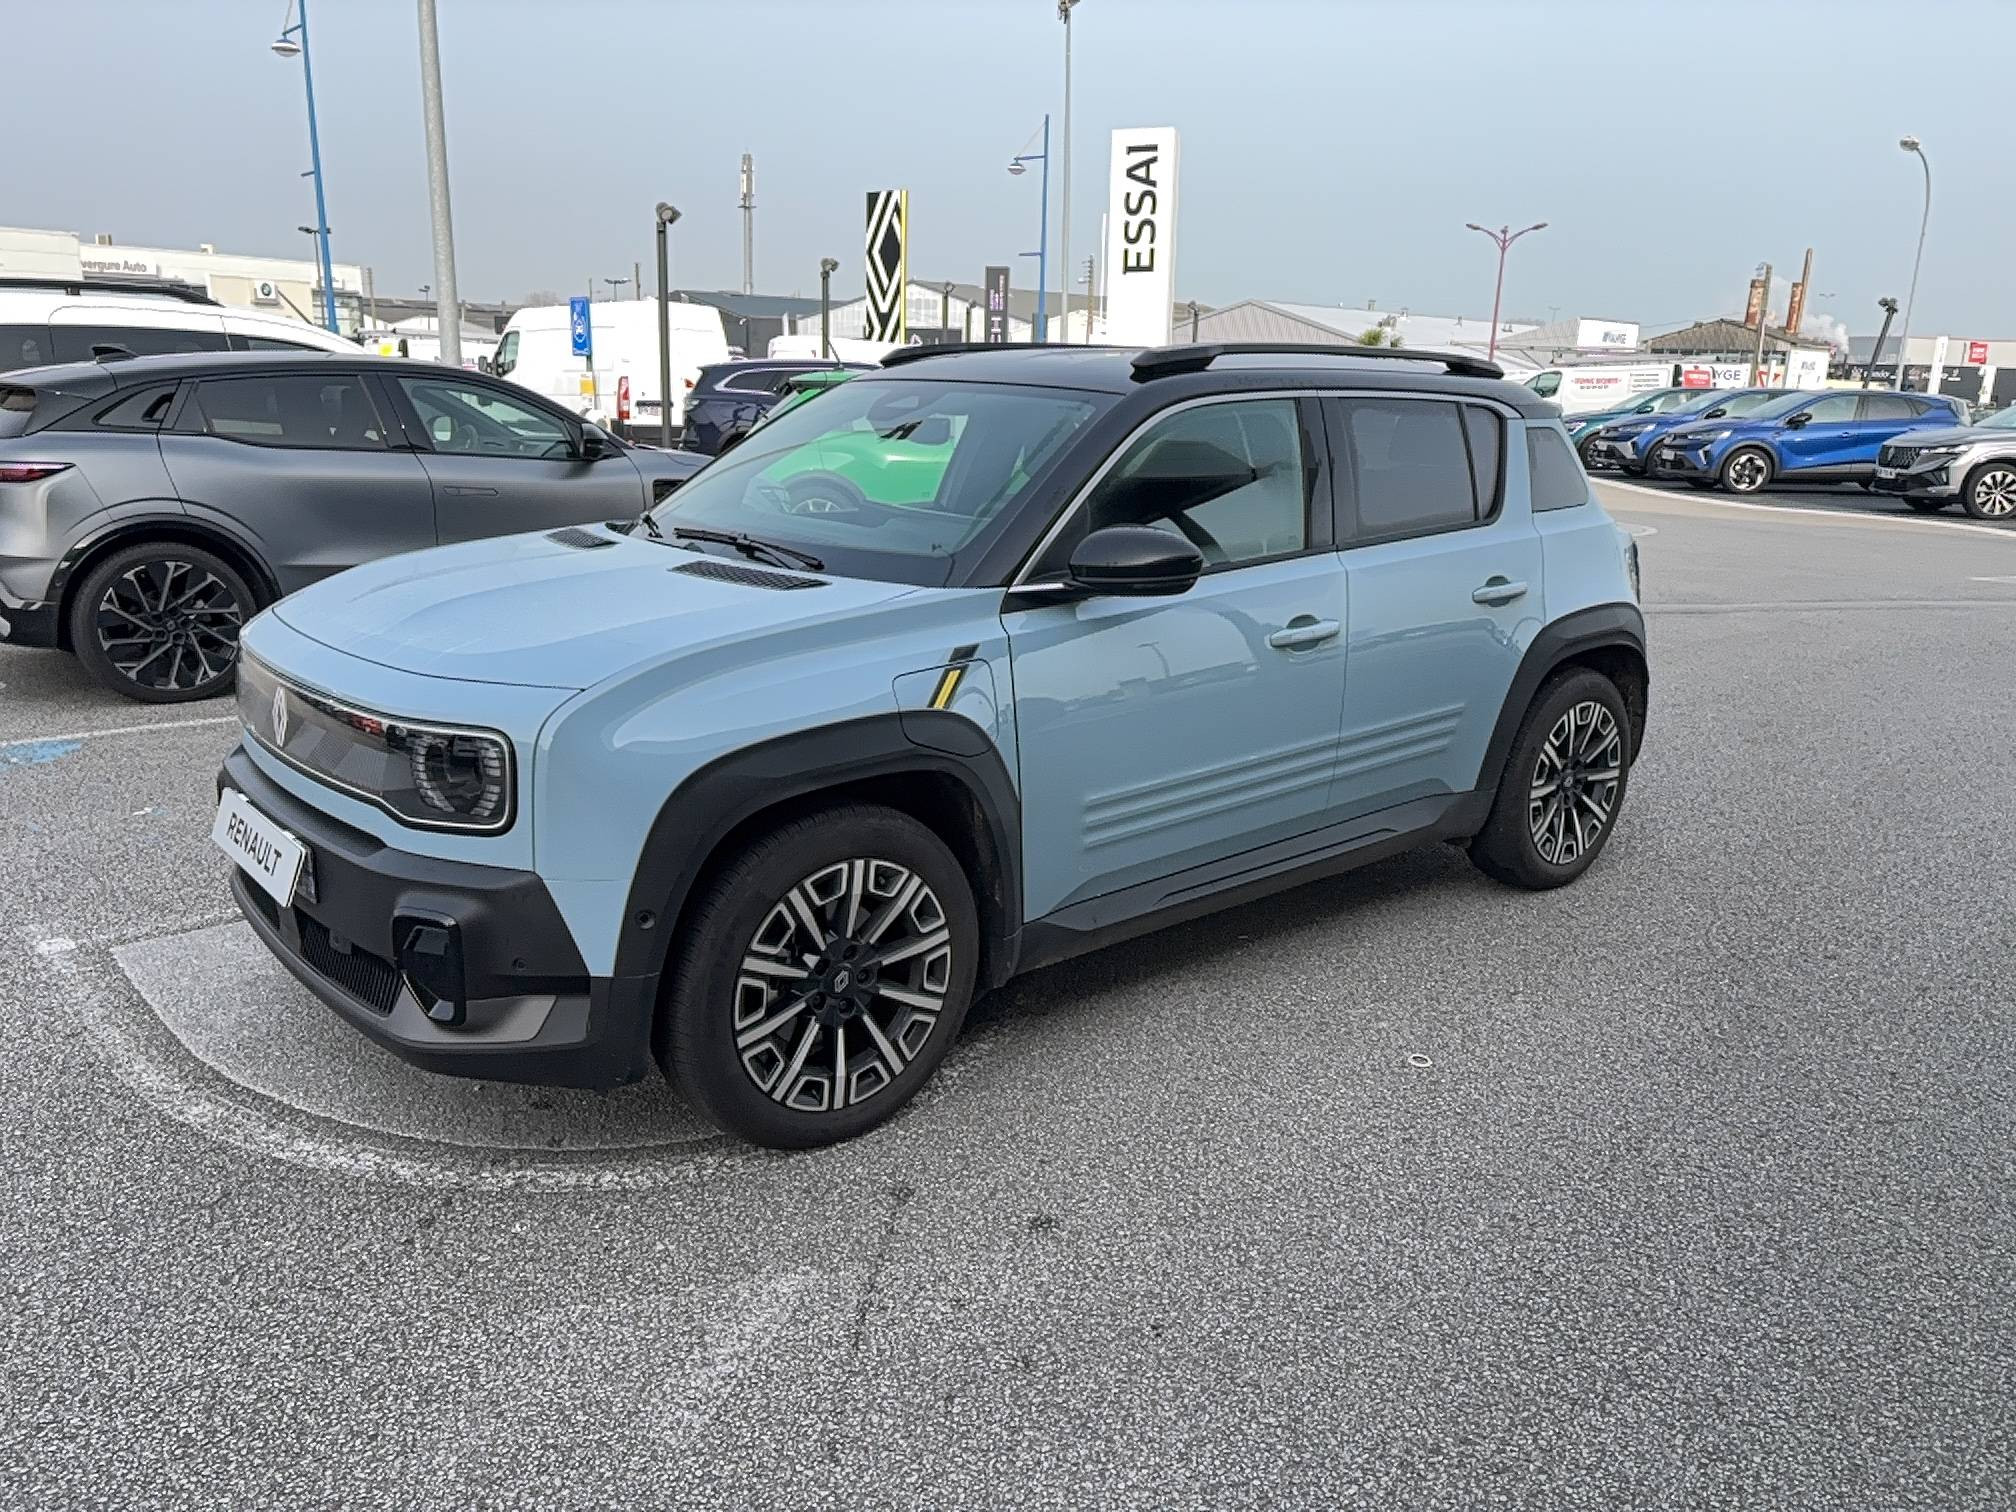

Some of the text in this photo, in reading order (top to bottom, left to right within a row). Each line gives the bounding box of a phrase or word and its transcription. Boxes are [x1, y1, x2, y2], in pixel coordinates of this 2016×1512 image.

[1123, 144, 1158, 275] ESSAI
[122, 259, 147, 273] Auto
[226, 811, 282, 877] RENAULT
